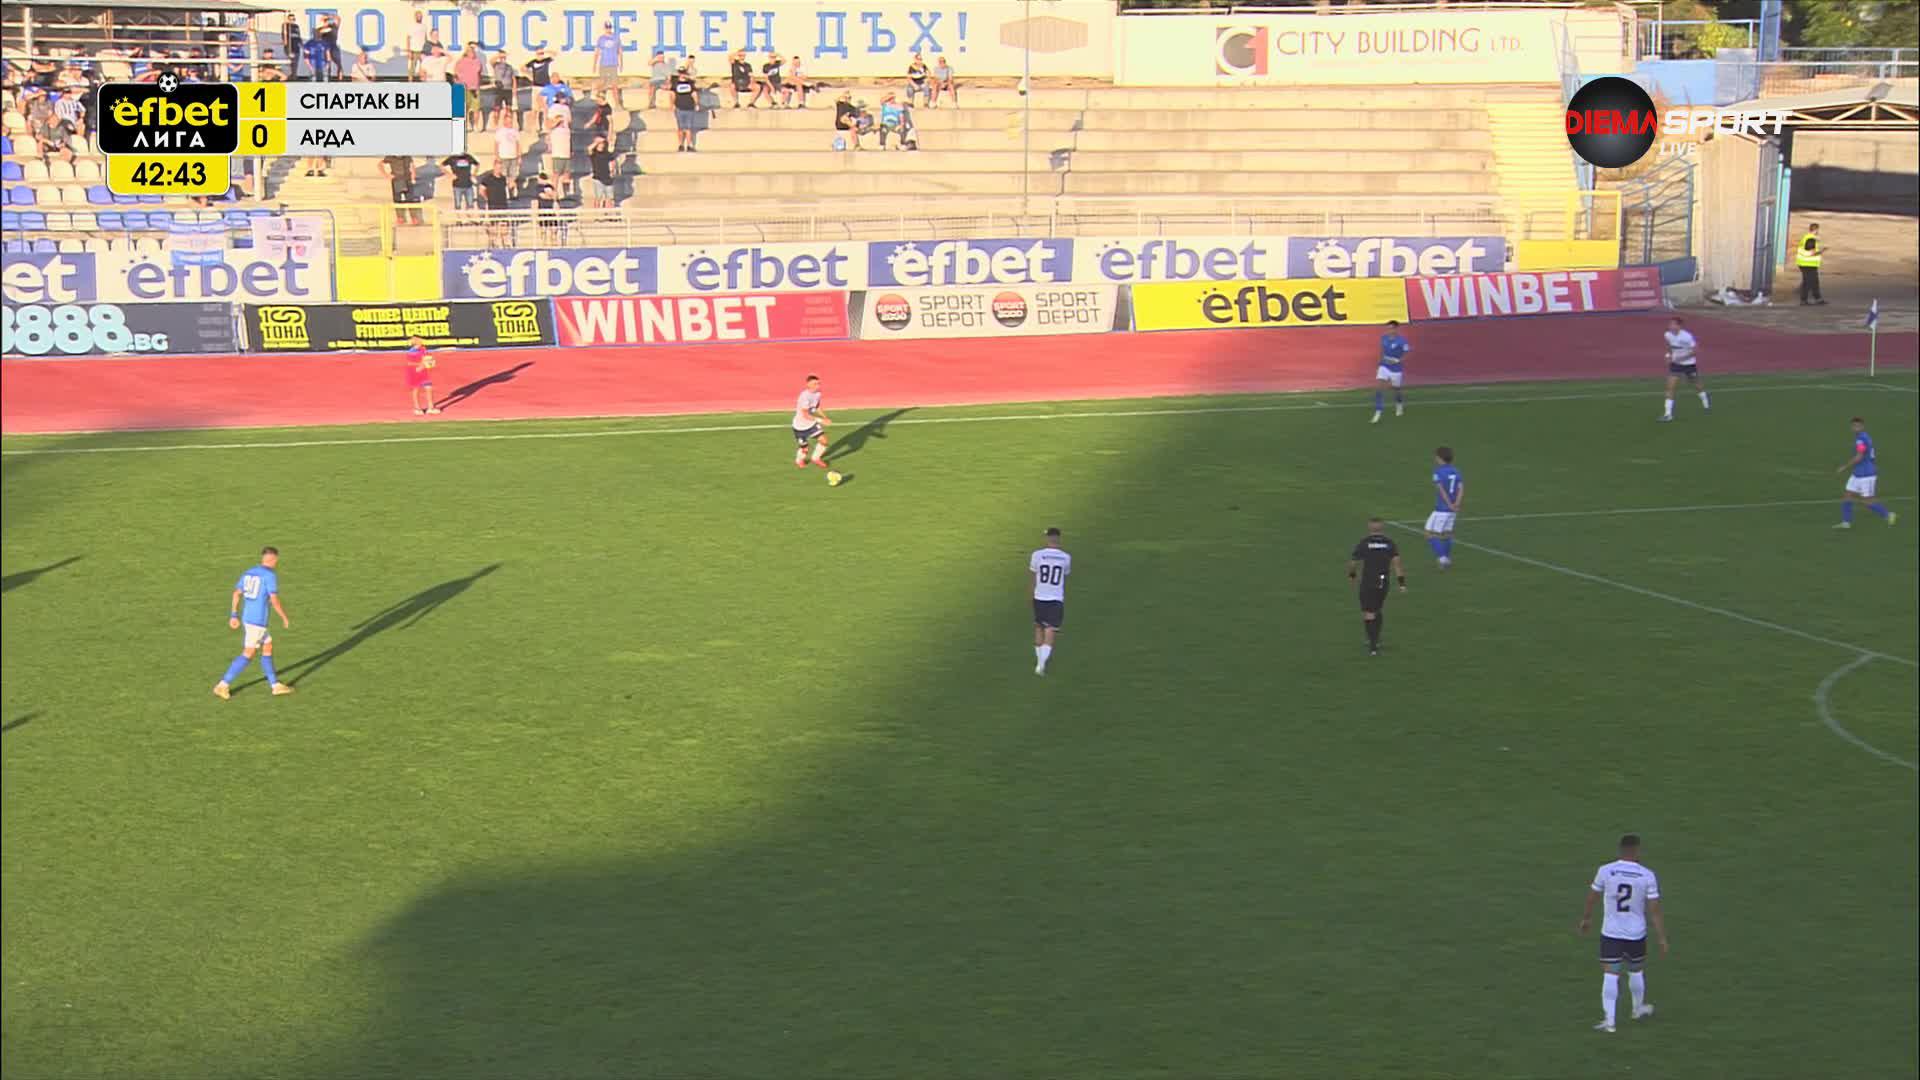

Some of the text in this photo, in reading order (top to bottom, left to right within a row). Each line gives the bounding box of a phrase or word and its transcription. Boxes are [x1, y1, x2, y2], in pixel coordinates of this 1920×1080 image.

[428, 9, 775, 57] ПОСЛЕДЕН
[814, 11, 968, 59] ДЪХ!
[1277, 31, 1345, 55] CITY
[1358, 28, 1481, 54] BUILDING
[468, 250, 640, 297] efbet
[686, 246, 848, 290] efbet
[893, 240, 1056, 286] efbet
[1100, 240, 1266, 280] efbet
[1313, 238, 1486, 278] efbet
[919, 294, 985, 311] SPORT
[1035, 291, 1100, 308] SPORT
[1202, 285, 1348, 324] efbet
[1420, 271, 1599, 318] WINBET
[571, 295, 777, 345] WINBET
[921, 312, 986, 328] DEPOT
[1037, 309, 1101, 325] DEPOT
[1448, 474, 1457, 493] 7
[1040, 564, 1063, 586] 80
[1617, 883, 1632, 913] 2
